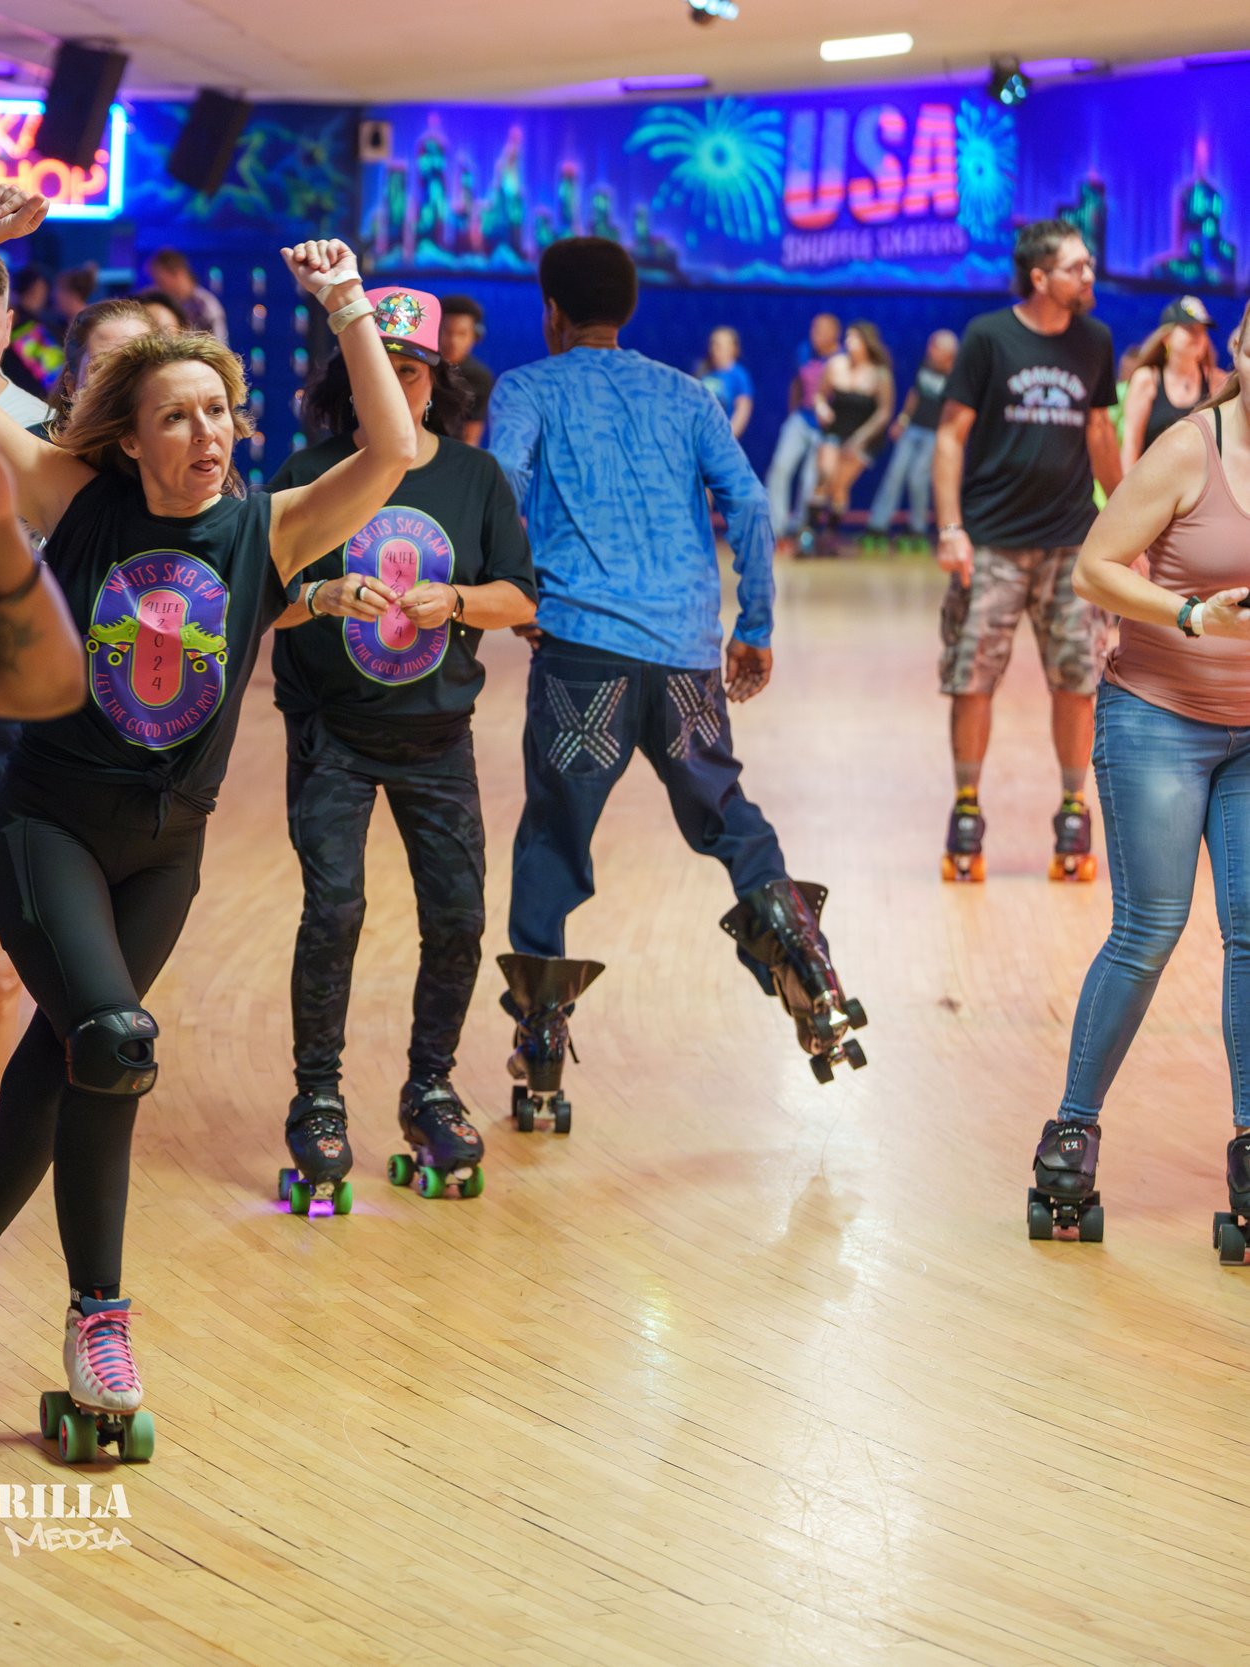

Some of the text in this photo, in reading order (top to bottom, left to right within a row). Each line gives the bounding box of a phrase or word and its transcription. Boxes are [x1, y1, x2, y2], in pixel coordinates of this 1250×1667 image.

[784, 102, 959, 230] USA
[396, 516, 424, 538] SK8
[163, 562, 198, 587] SK8
[105, 698, 127, 723] THE
[126, 717, 161, 738] GOOD
[165, 707, 201, 736] TIMES
[196, 683, 218, 713] ROLL
